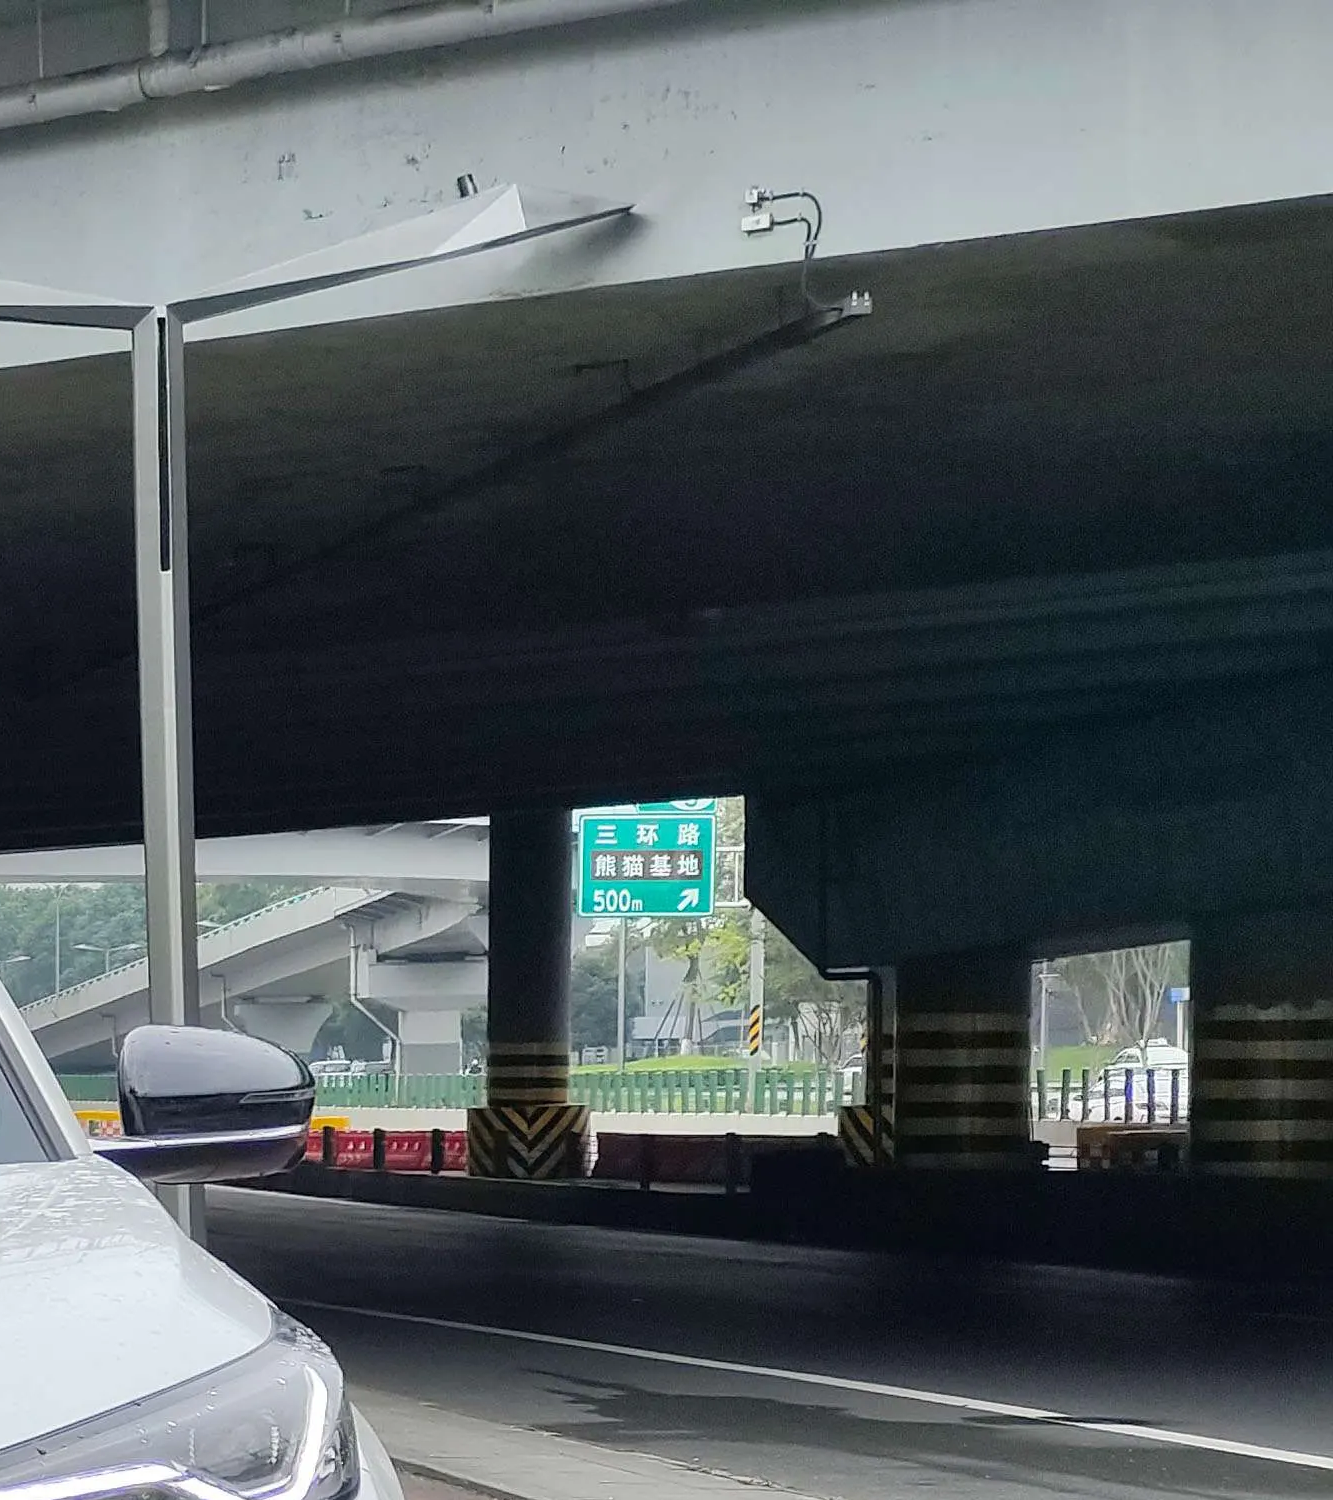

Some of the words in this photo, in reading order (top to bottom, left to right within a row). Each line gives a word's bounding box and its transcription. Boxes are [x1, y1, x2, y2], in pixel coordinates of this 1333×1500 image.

[595, 824, 701, 845] 三环路
[594, 855, 699, 877] 熊猫基地
[593, 889, 643, 912] 500m
